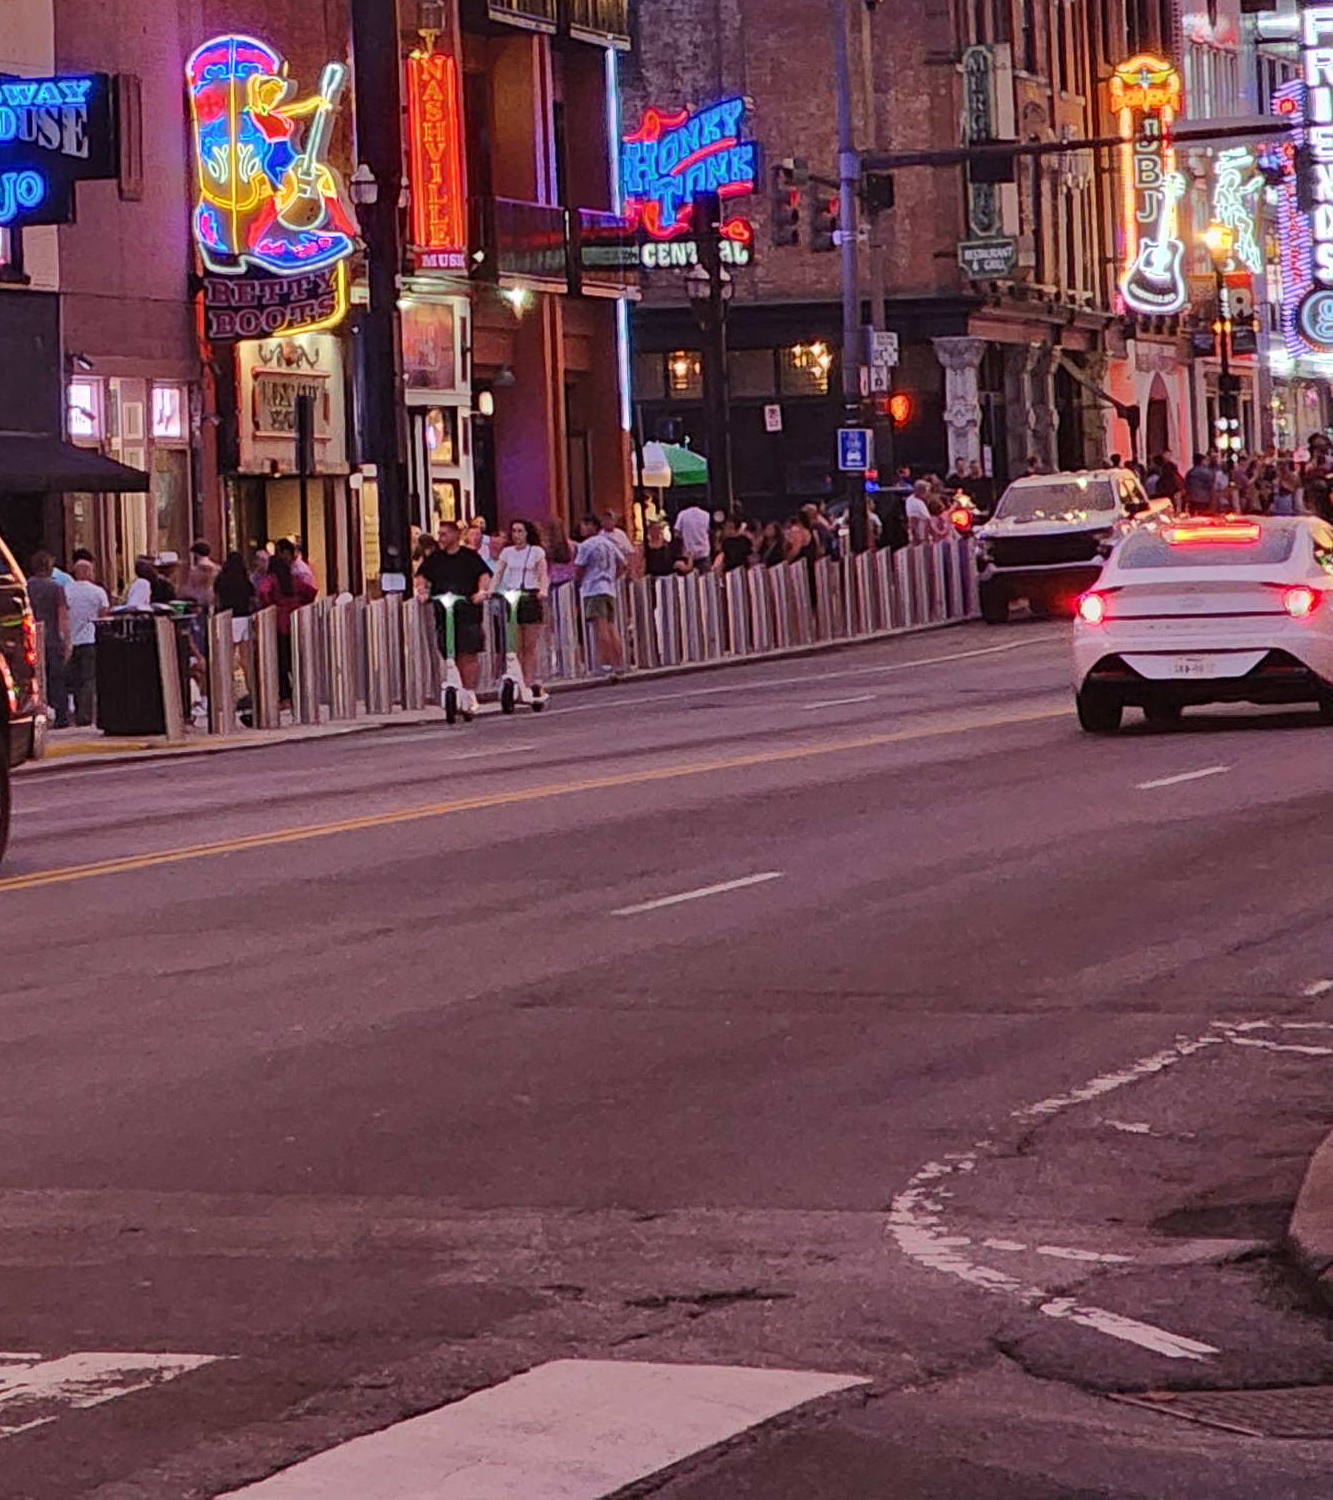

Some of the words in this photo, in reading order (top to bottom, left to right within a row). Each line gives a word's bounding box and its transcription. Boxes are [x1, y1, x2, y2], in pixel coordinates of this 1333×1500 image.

[420, 56, 450, 247] NASHVILLE
[623, 100, 744, 196] HONKY
[650, 144, 754, 227] TONK
[204, 270, 337, 307] BETTY
[208, 293, 338, 339] BOOTS
